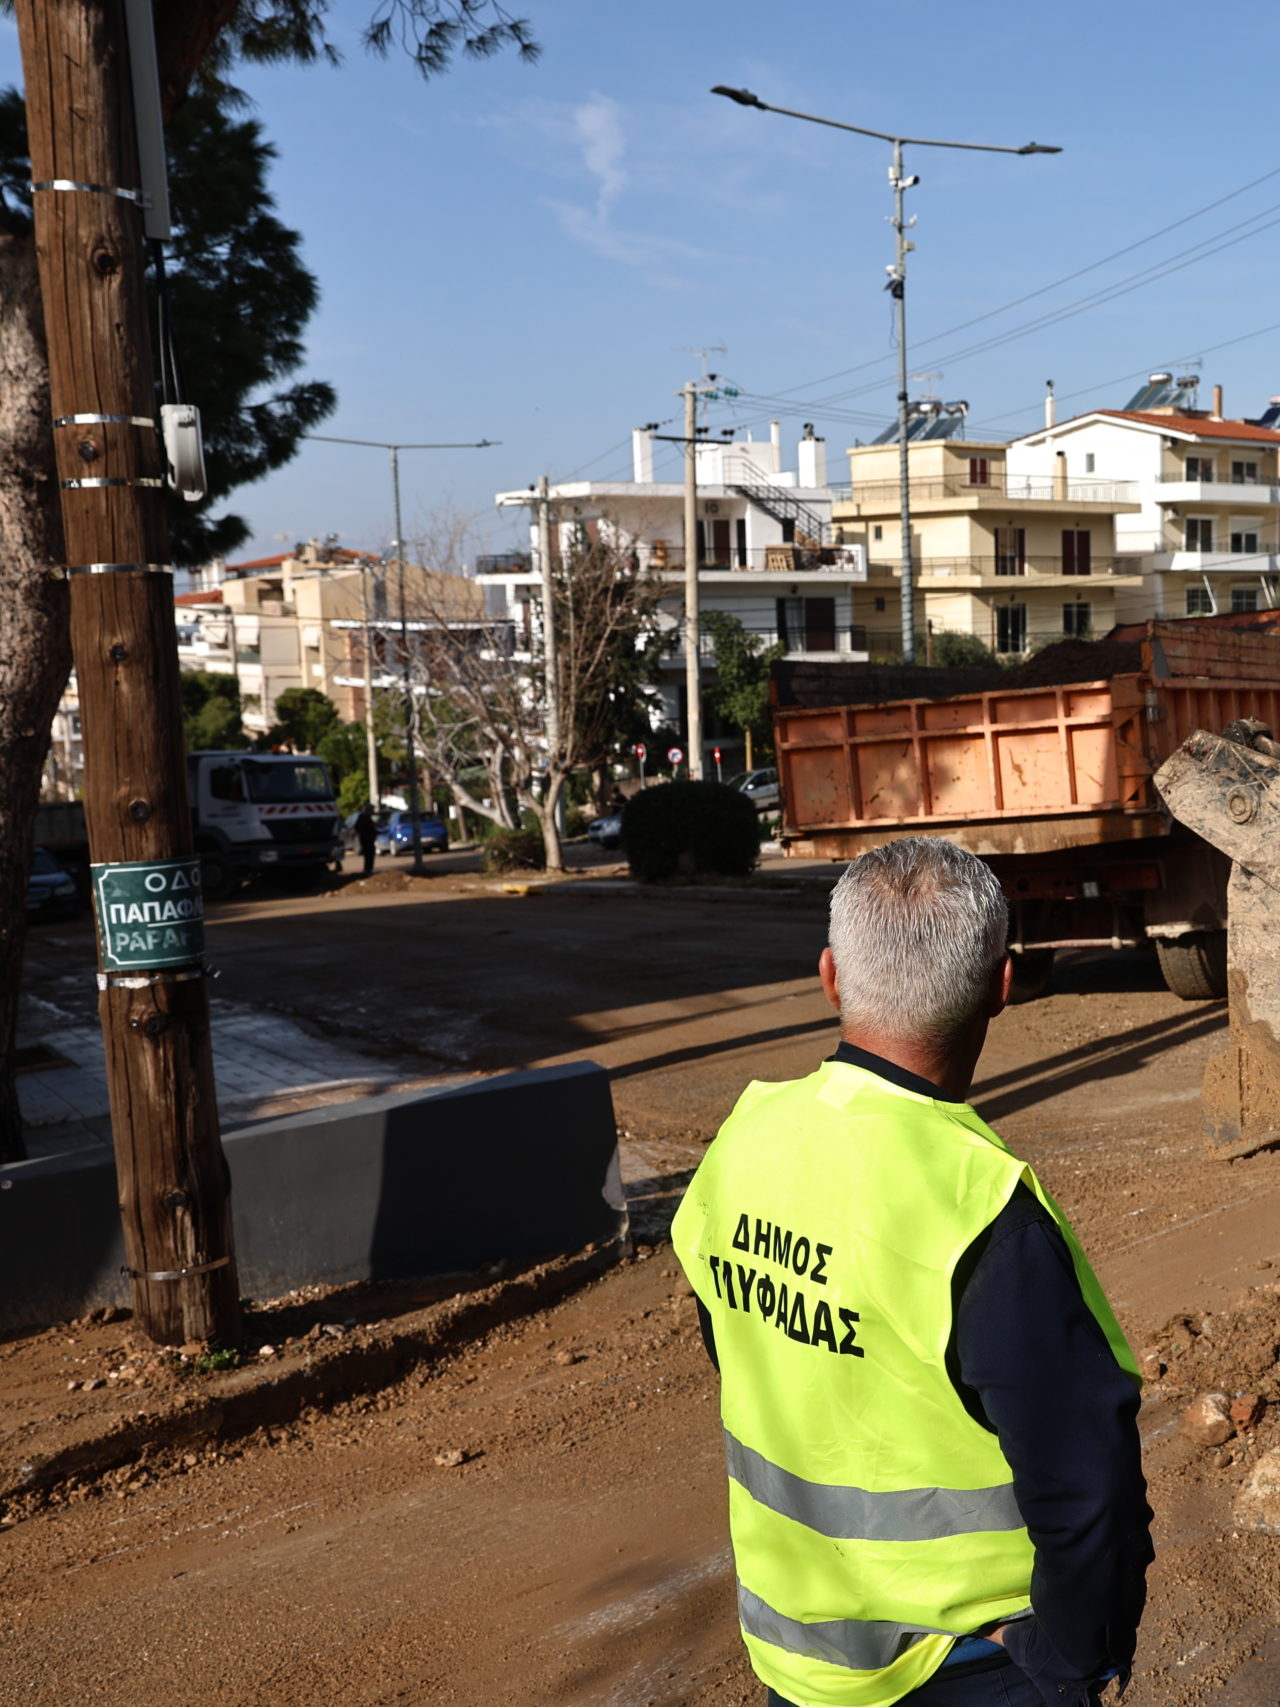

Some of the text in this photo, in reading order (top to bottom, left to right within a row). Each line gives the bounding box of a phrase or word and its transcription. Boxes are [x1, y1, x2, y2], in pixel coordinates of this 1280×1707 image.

[109, 896, 204, 925] ΠΑΠΑΦΛ
[732, 1213, 833, 1285] ΔΗΜΟΣ
[709, 1255, 865, 1359] ΓΛΥΦΑΔΑΣ
